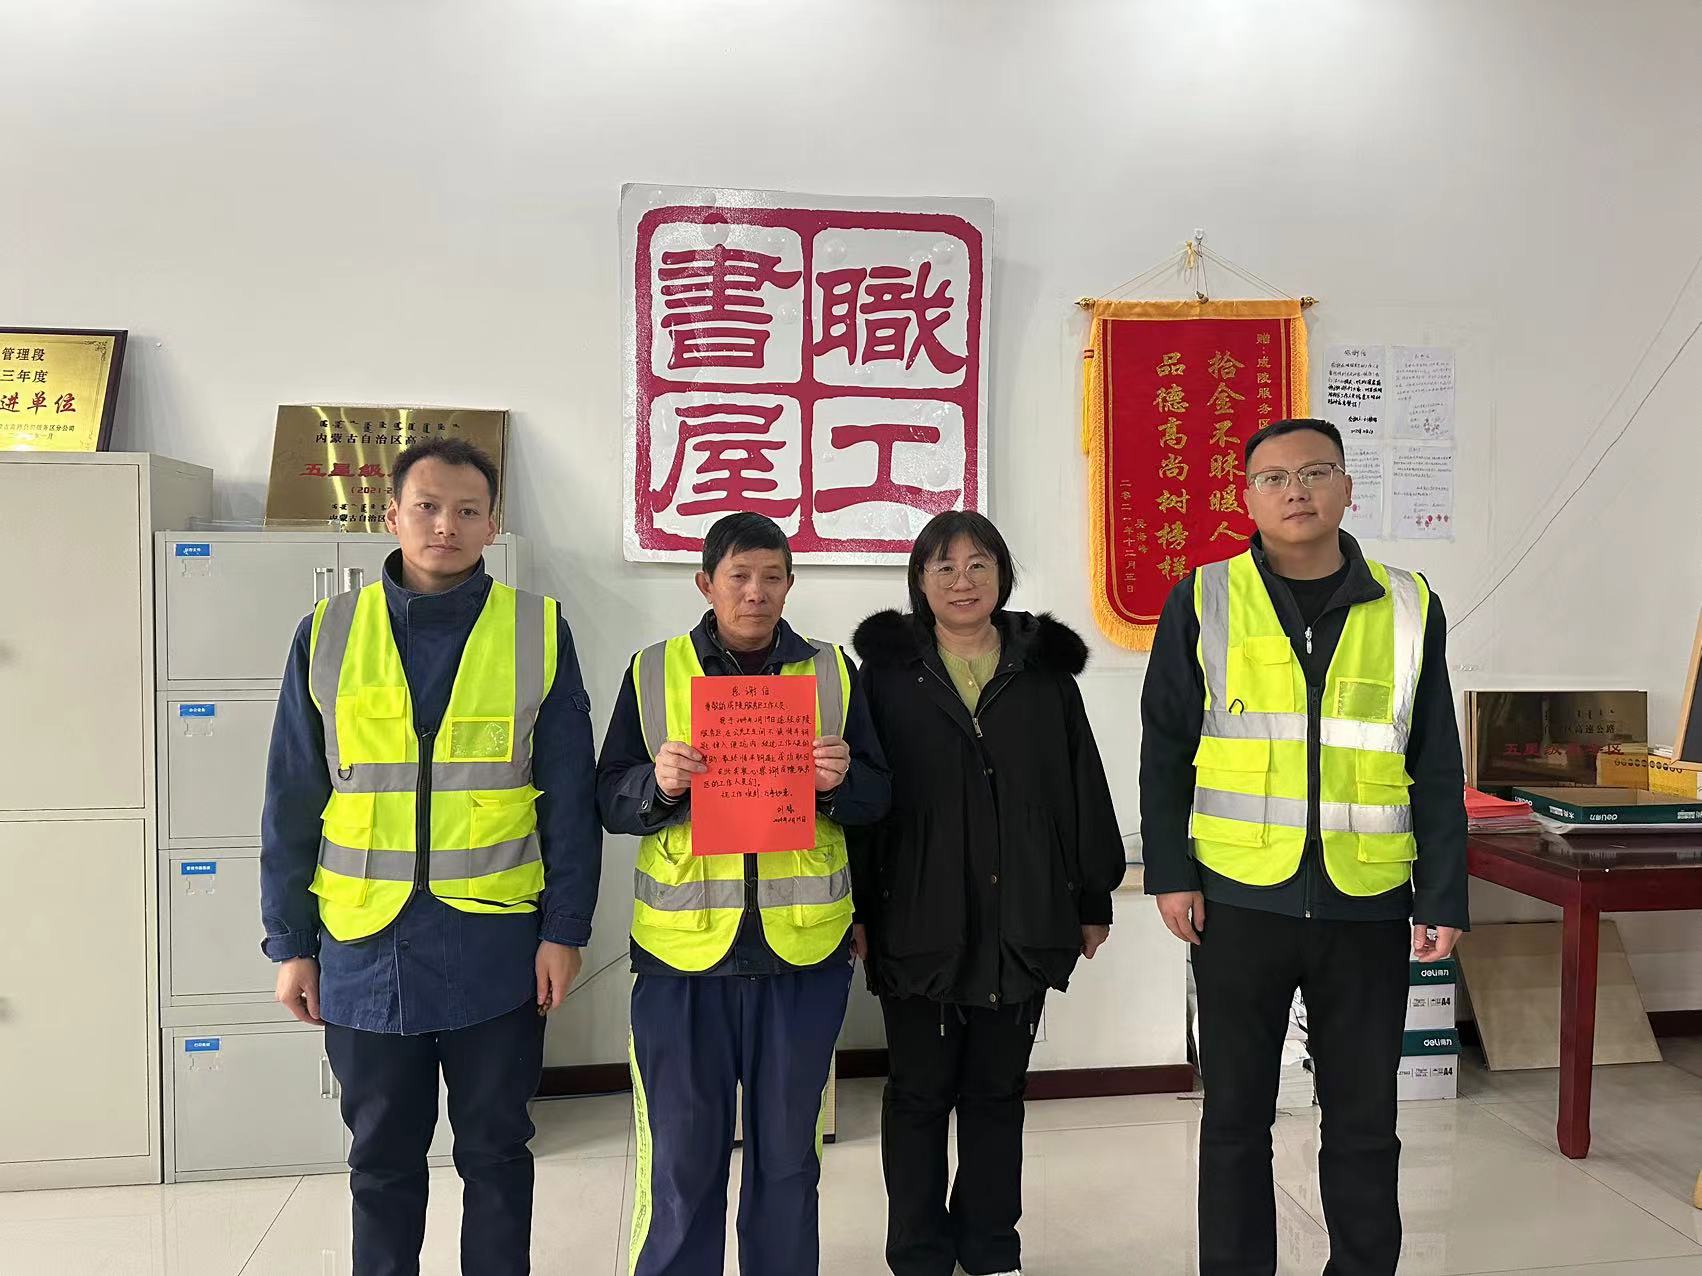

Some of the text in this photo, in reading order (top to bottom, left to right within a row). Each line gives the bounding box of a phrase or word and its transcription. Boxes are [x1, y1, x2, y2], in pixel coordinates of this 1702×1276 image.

[1, 346, 46, 362] 管理段
[0, 369, 49, 383] 三年度
[0, 391, 77, 415] 进单位
[299, 463, 394, 478] 五星级
[1152, 351, 1190, 582] 品德高尚树榜样
[1441, 997, 1451, 1006] A4
[1443, 1067, 1453, 1076] A4
